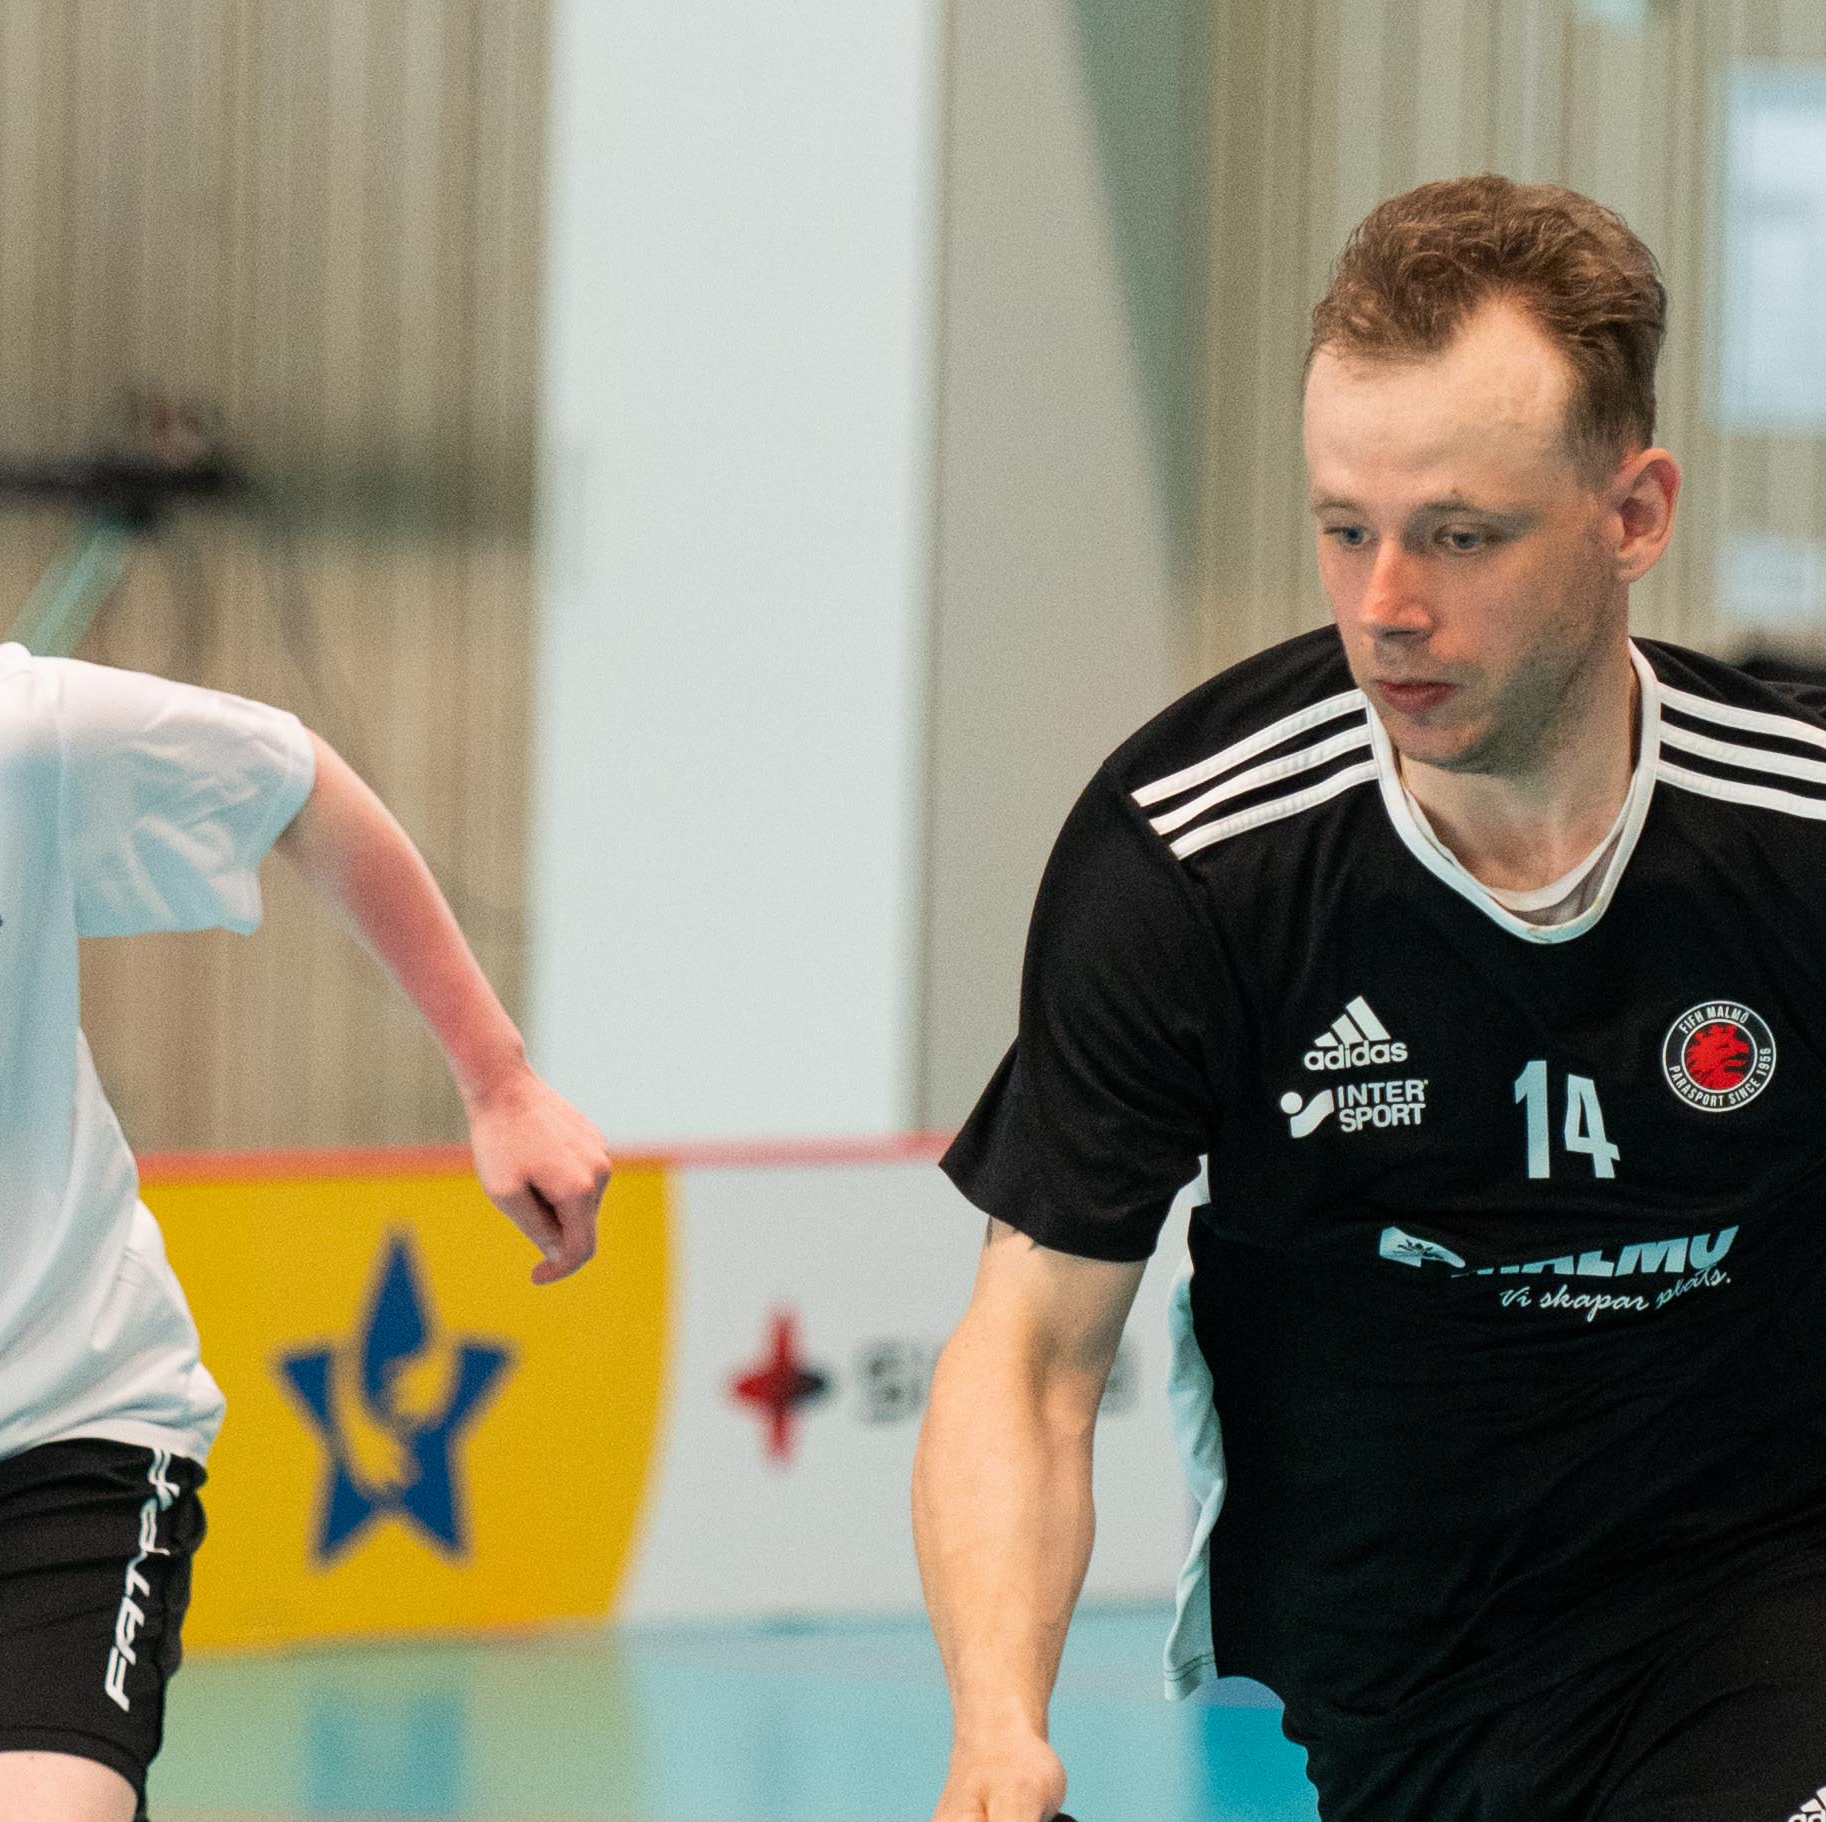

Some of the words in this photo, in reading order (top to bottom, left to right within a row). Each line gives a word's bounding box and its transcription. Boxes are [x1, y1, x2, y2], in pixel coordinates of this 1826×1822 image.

[1678, 1010, 1704, 1034] FIFH
[1303, 1039, 1409, 1071] adidas
[1668, 1065, 1724, 1107] PARASPORT
[1728, 1078, 1761, 1105] SINCE
[1756, 1047, 1772, 1076] 1956
[1337, 1079, 1426, 1109] INTER
[1338, 1103, 1426, 1133] SPORT
[1514, 1059, 1621, 1179] 14
[1500, 1286, 1532, 1308] Vi
[1540, 1284, 1650, 1323] skapar
